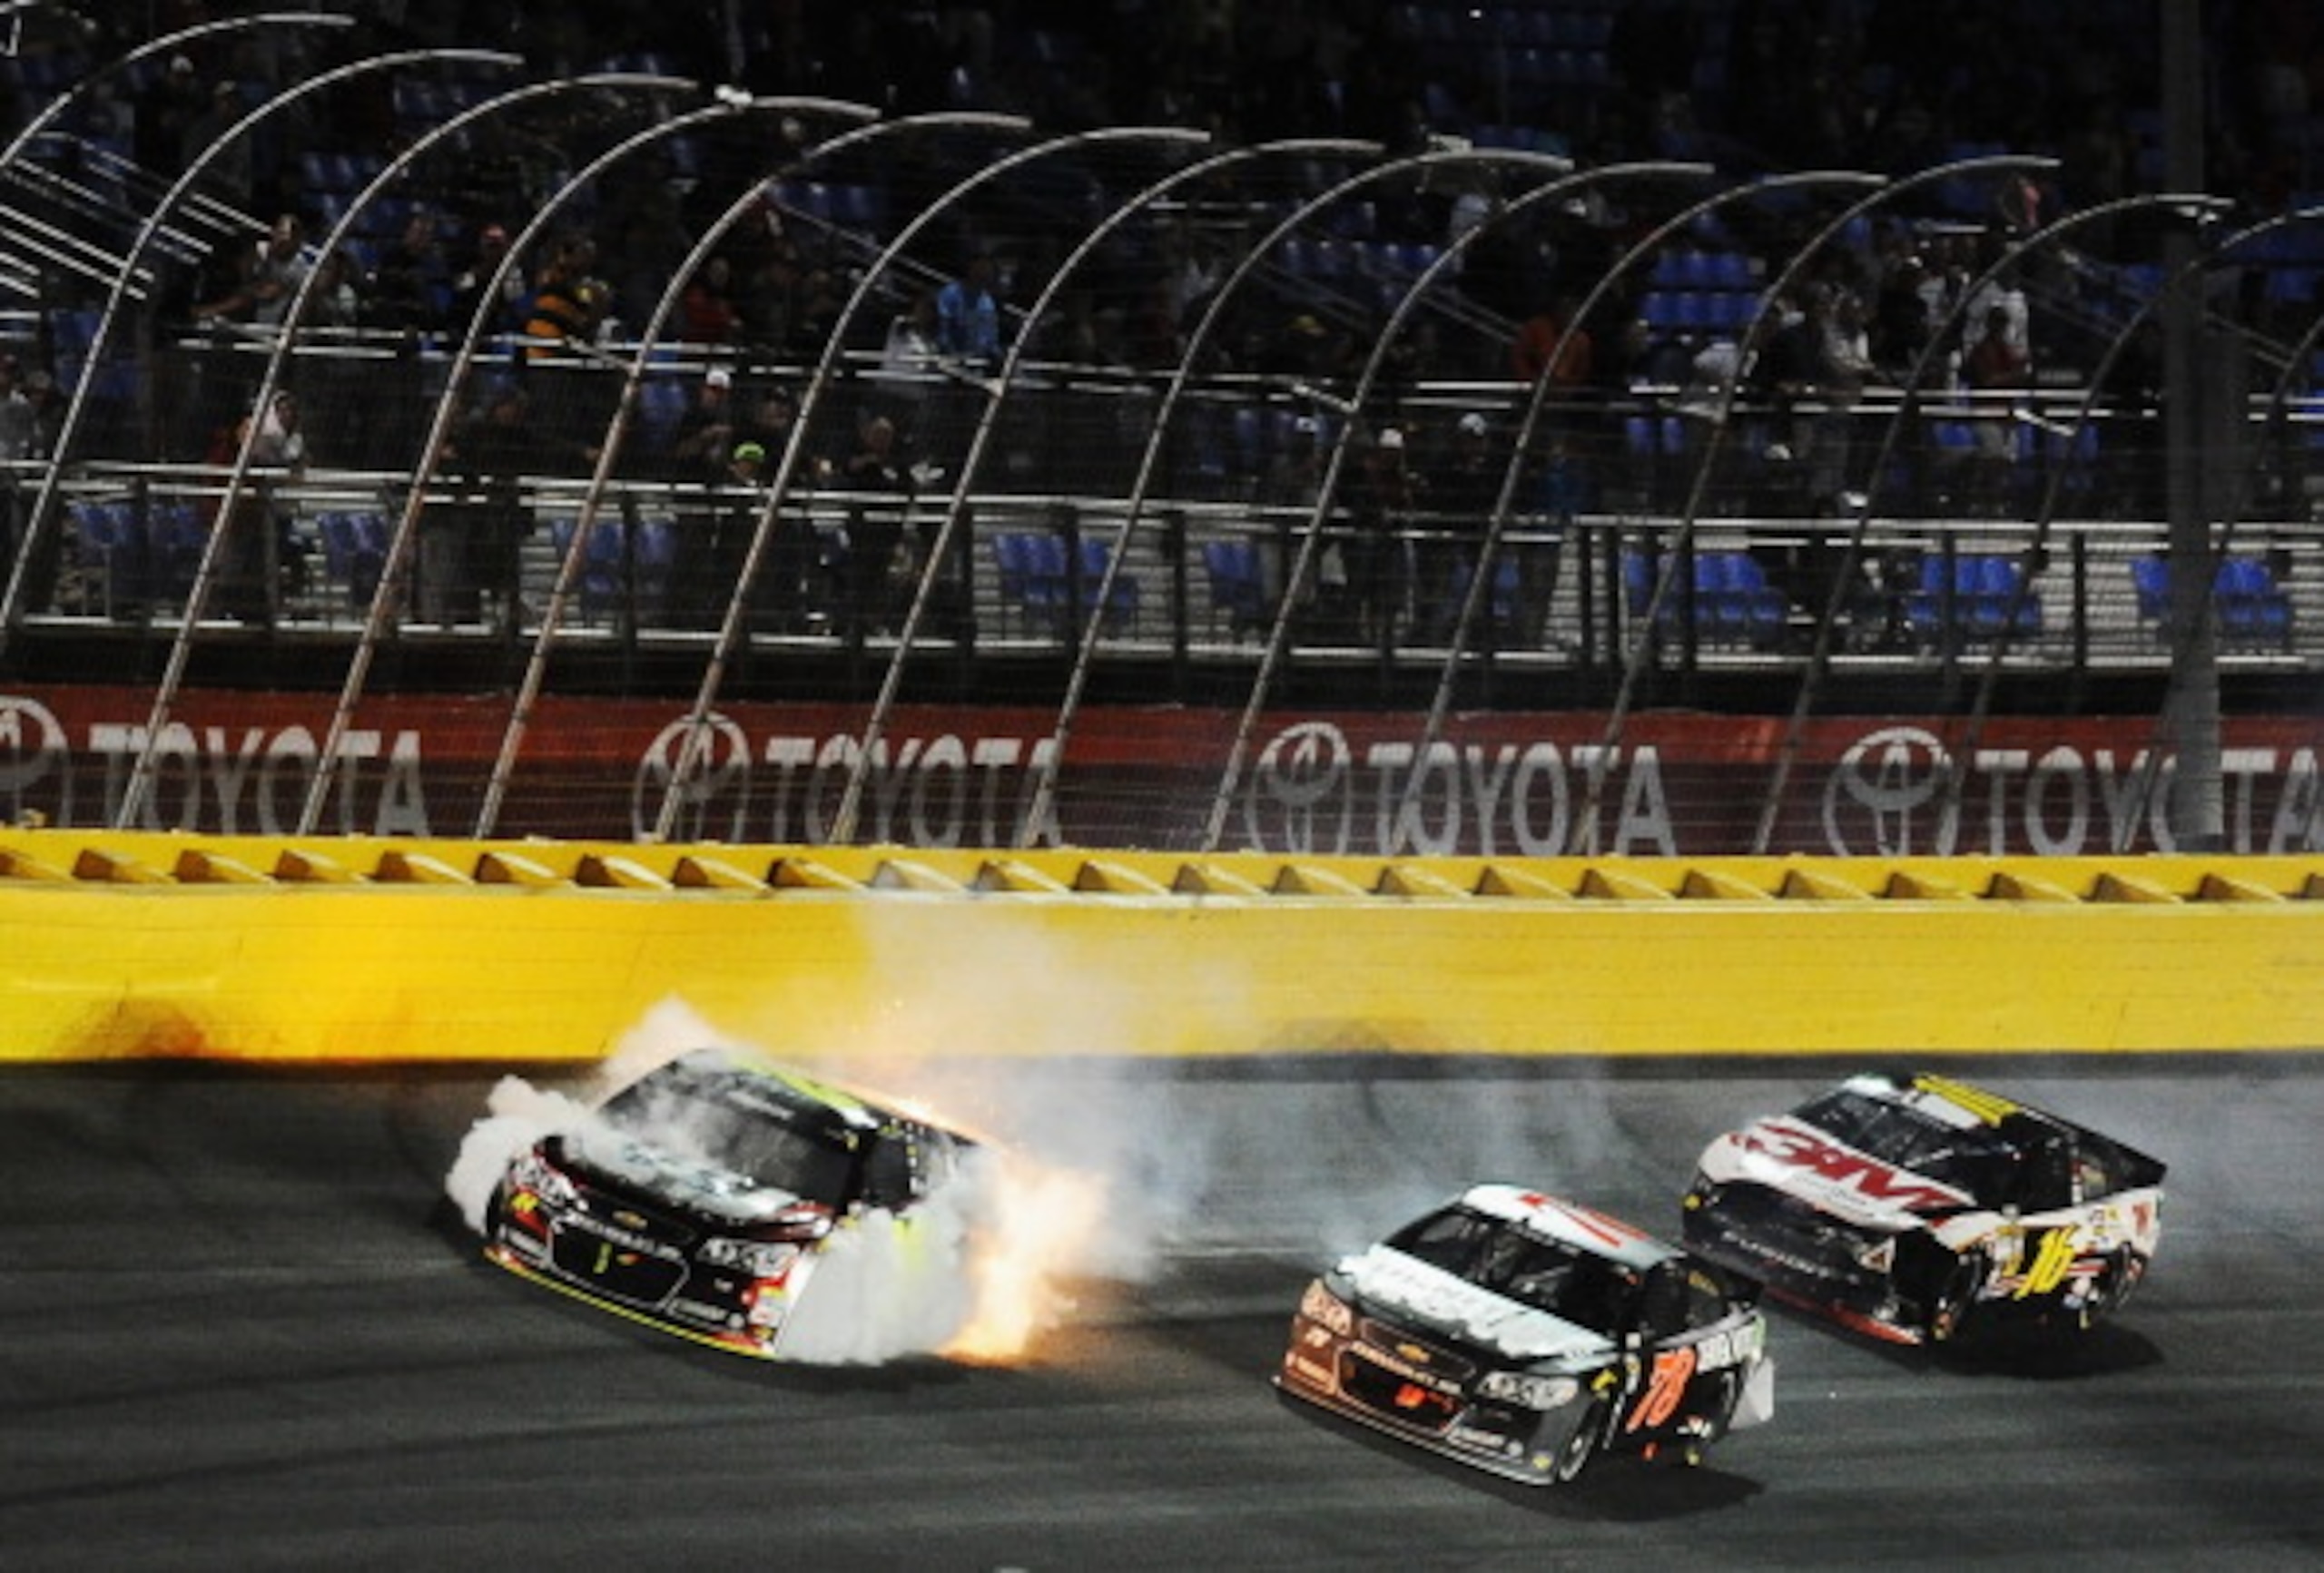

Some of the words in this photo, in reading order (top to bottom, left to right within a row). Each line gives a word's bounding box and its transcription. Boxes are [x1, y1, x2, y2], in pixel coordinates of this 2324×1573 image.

[90, 723, 431, 837] TOYOTA
[764, 733, 1063, 848] TOYOTA
[1367, 741, 1678, 858] TOYOTA
[1728, 1122, 1967, 1211] 3M
[2012, 1224, 2078, 1302] 16
[1625, 1346, 1696, 1433] 78
